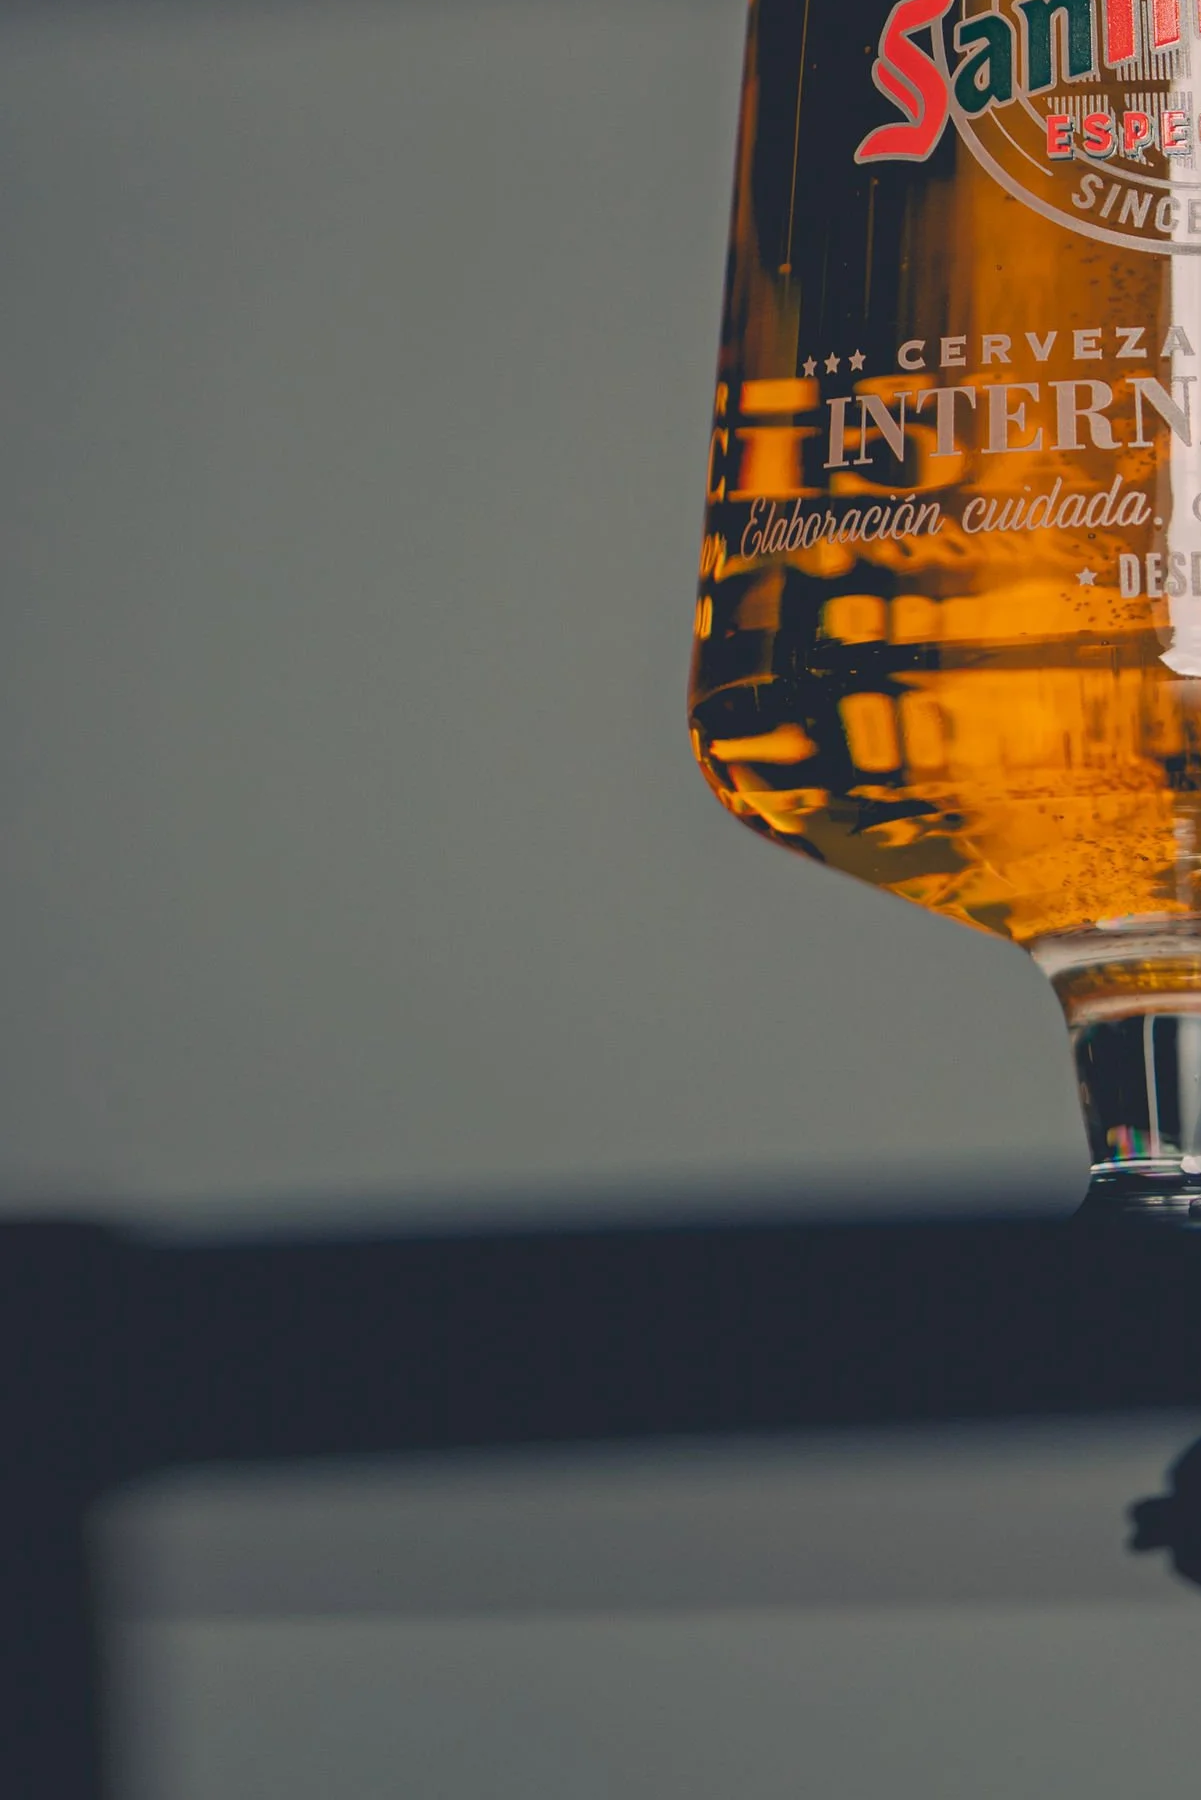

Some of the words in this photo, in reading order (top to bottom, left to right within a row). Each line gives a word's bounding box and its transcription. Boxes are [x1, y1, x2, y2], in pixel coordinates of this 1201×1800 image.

[897, 324, 1196, 370] CERVEZA
[740, 492, 943, 561] Elaboración
[961, 474, 1164, 533] cuidada.
